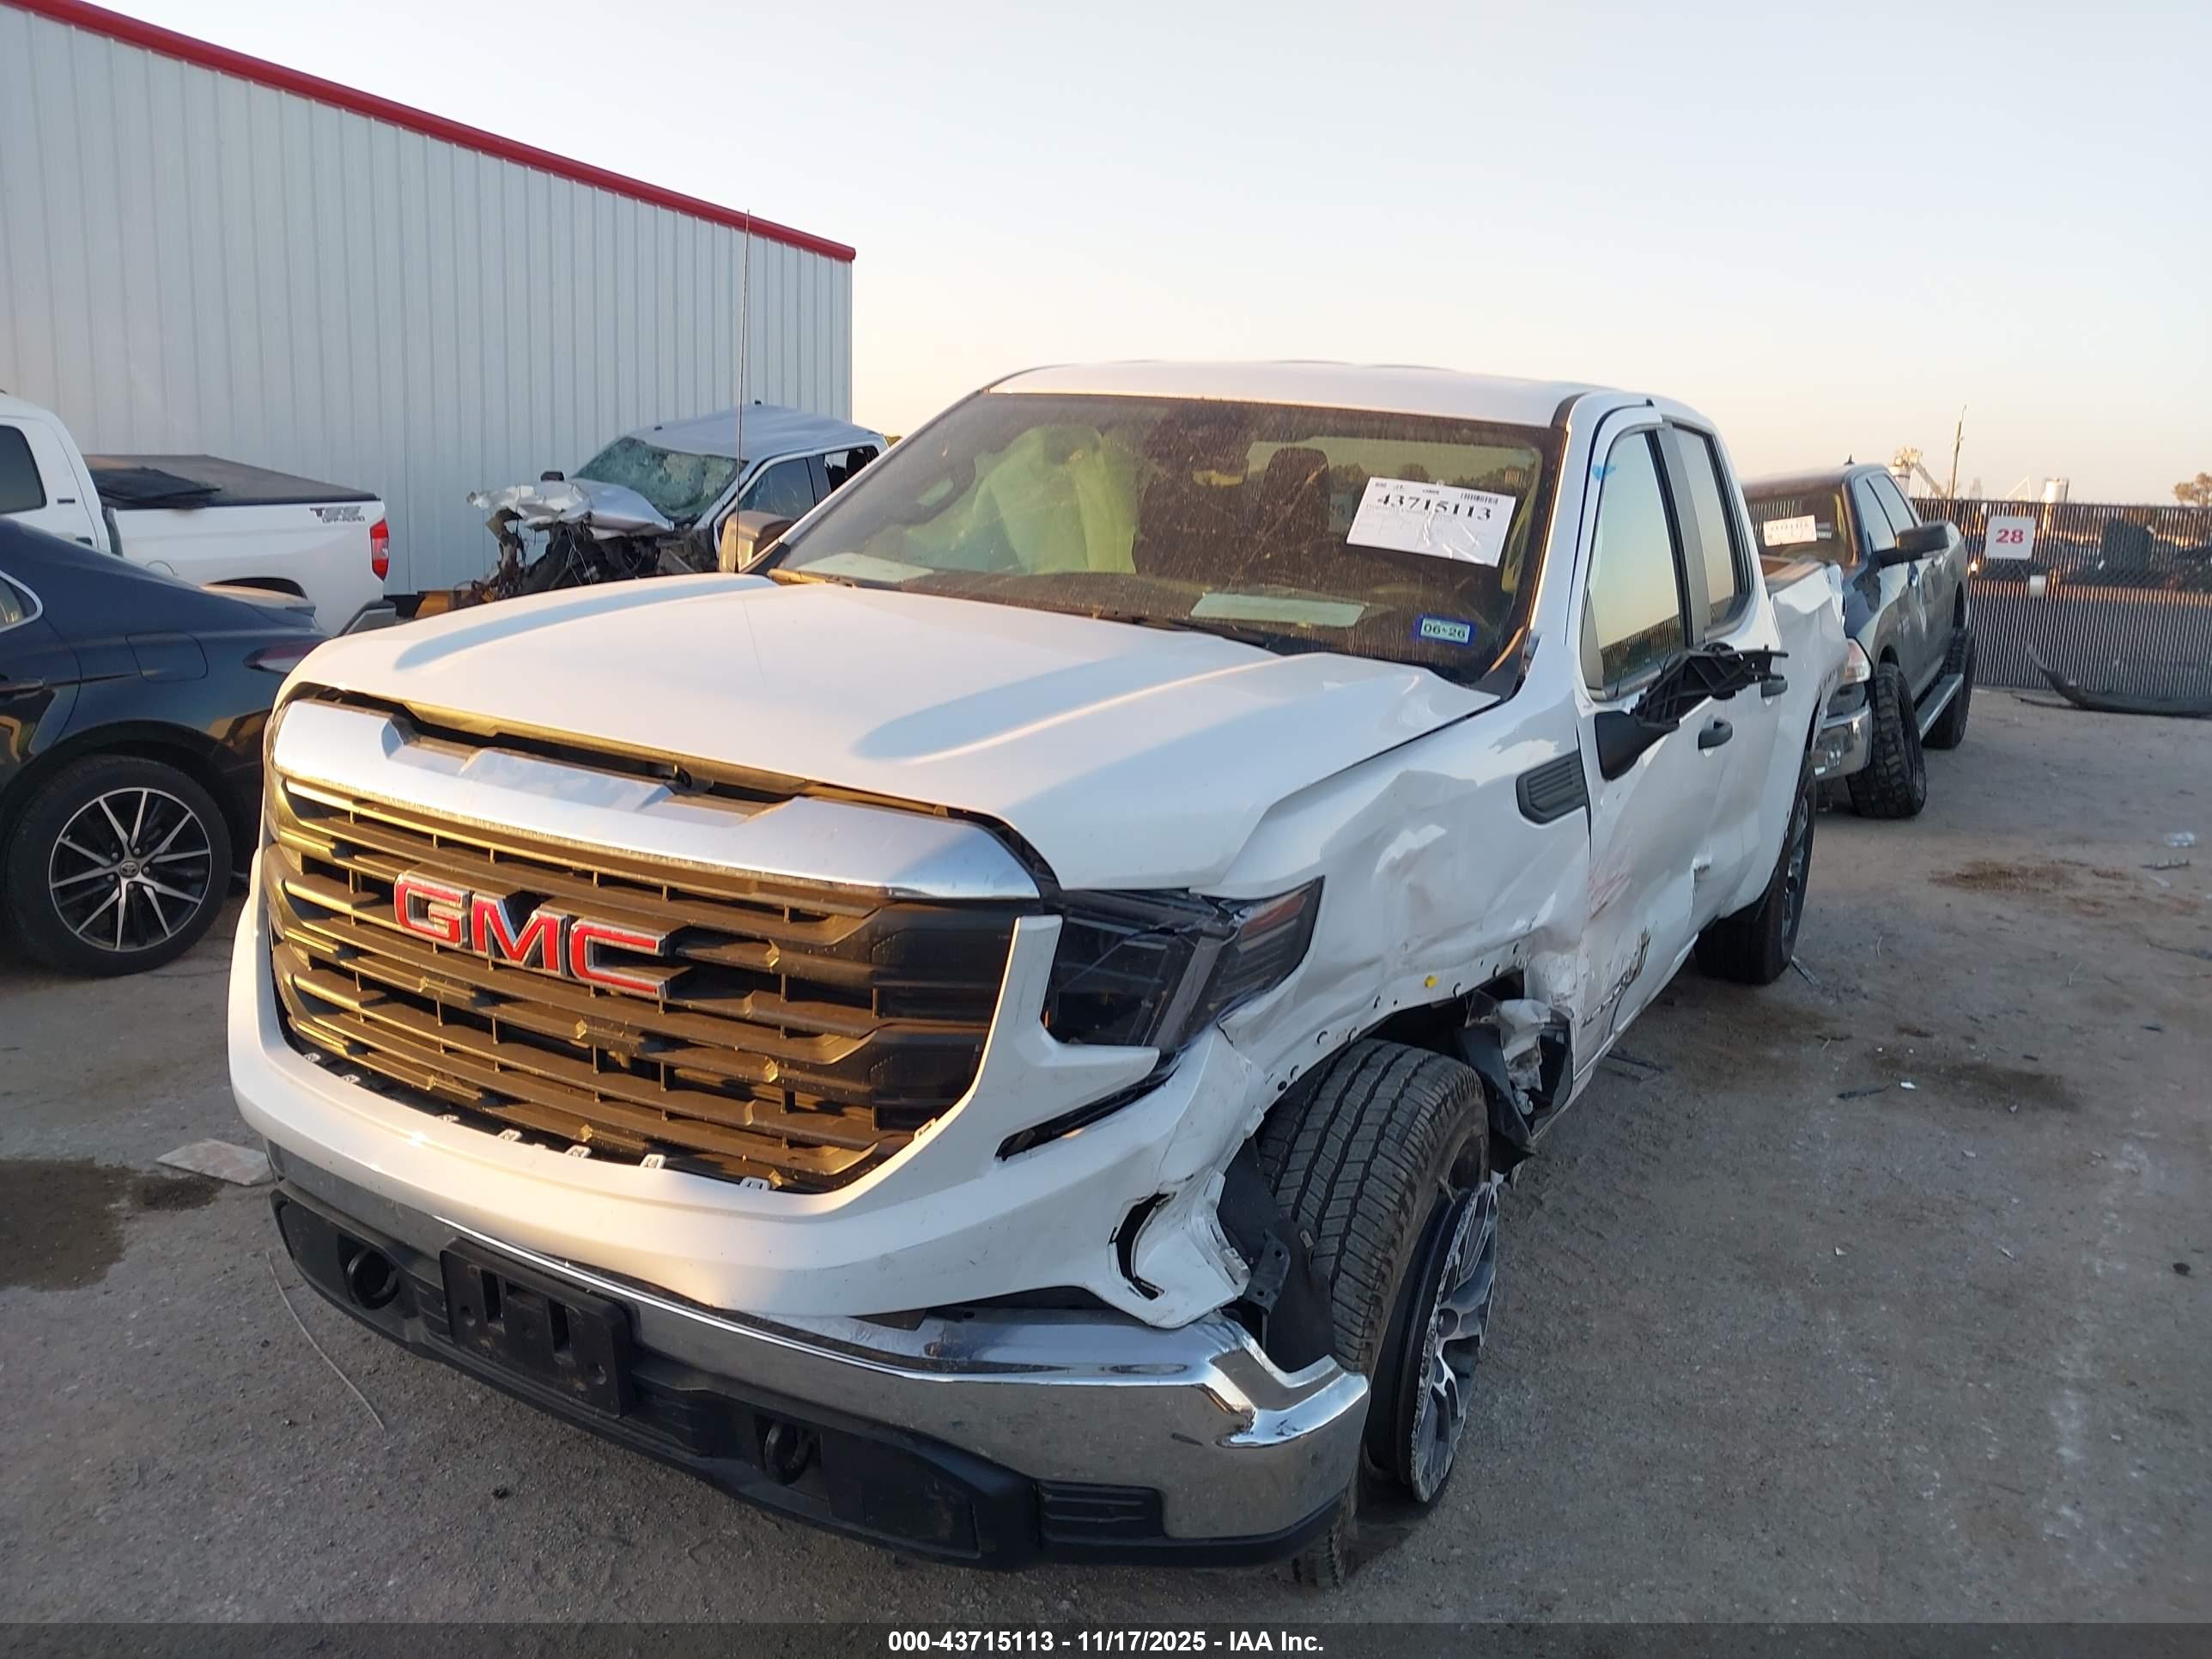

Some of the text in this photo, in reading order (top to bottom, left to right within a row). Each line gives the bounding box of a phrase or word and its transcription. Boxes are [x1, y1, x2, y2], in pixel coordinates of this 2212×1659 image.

[1377, 492, 1492, 522] 43715113
[1996, 528, 2024, 544] 28
[394, 872, 667, 999] GMC
